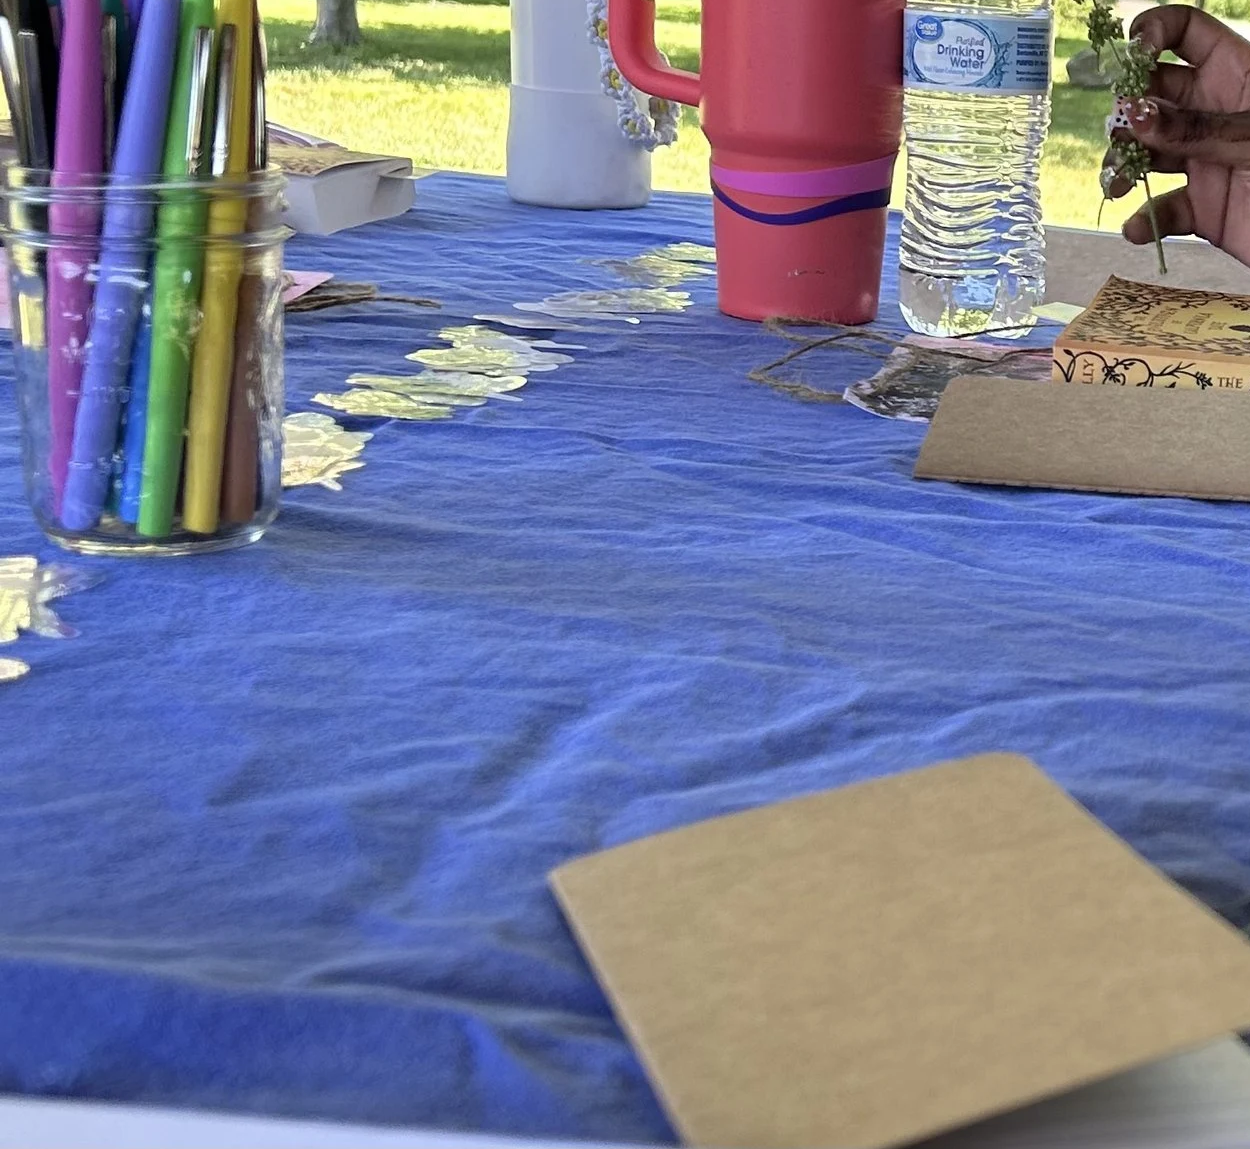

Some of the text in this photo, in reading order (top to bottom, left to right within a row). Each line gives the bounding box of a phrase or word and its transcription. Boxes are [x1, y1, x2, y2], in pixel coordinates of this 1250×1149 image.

[918, 21, 938, 31] Great
[956, 36, 986, 47] Purified
[937, 44, 985, 60] Drinking
[950, 57, 985, 69] Water
[1217, 376, 1243, 389] THE
